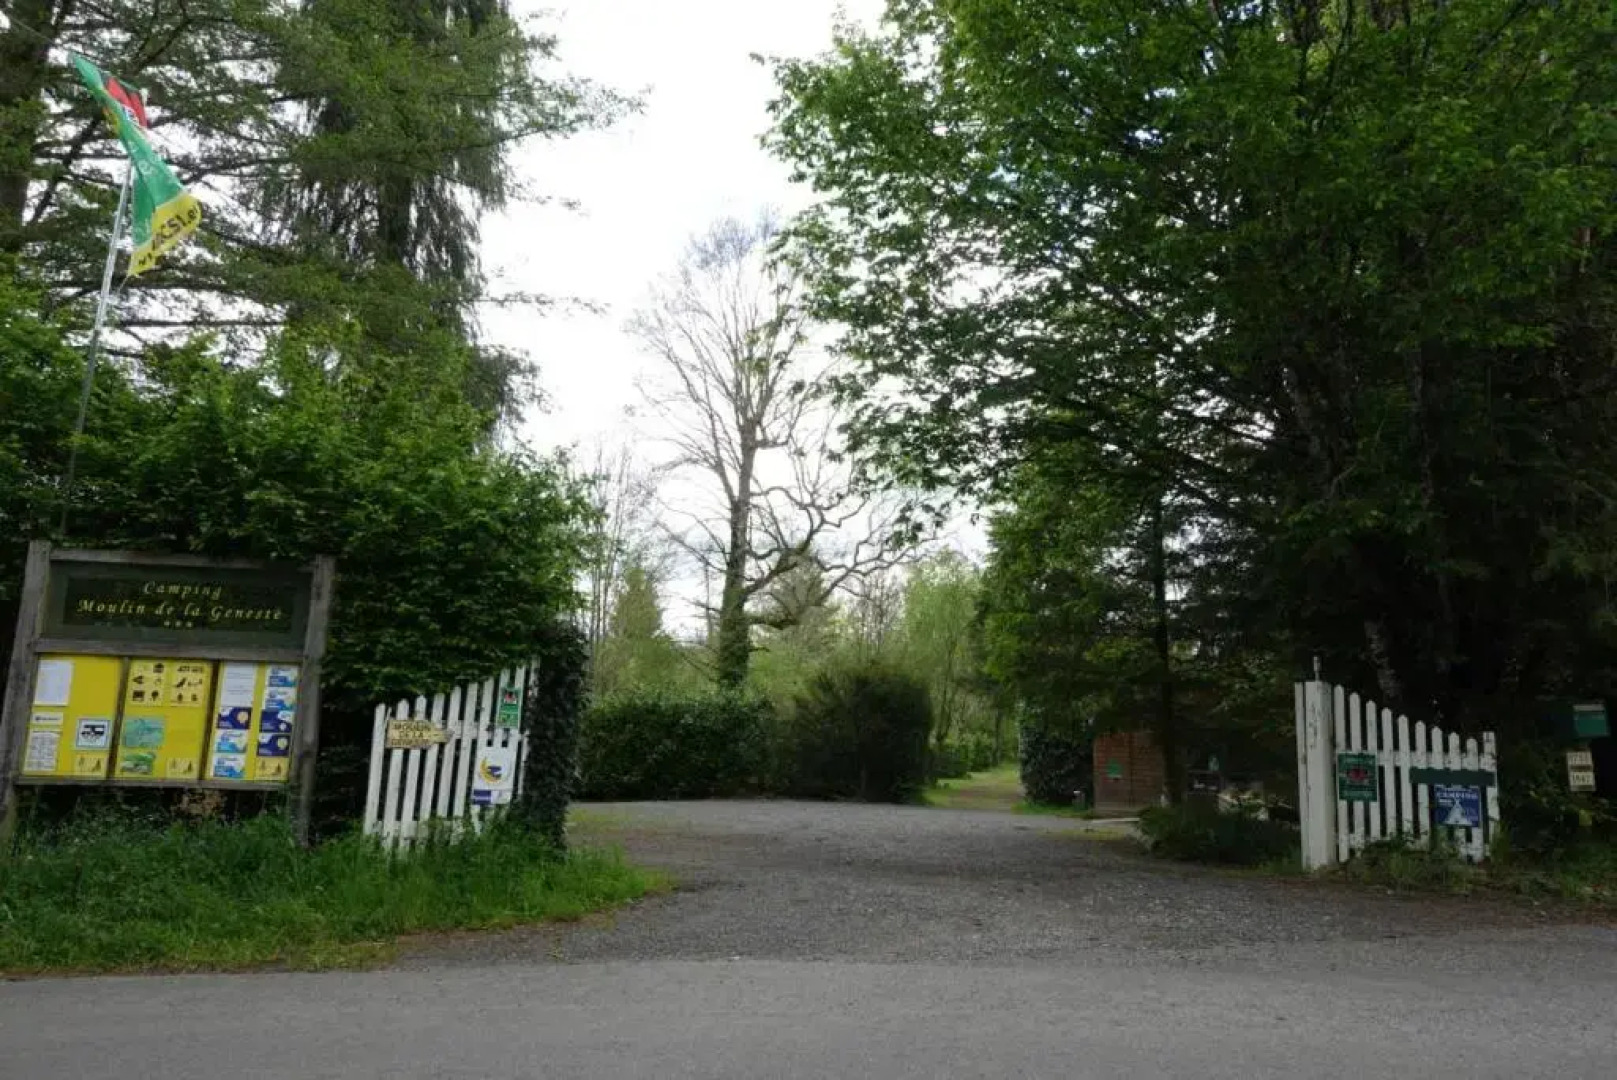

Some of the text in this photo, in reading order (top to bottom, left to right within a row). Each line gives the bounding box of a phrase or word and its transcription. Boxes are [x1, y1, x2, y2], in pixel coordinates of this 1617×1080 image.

[143, 581, 221, 600] Camping
[77, 599, 146, 614] Moulin
[155, 601, 175, 615] de
[184, 602, 200, 616] la
